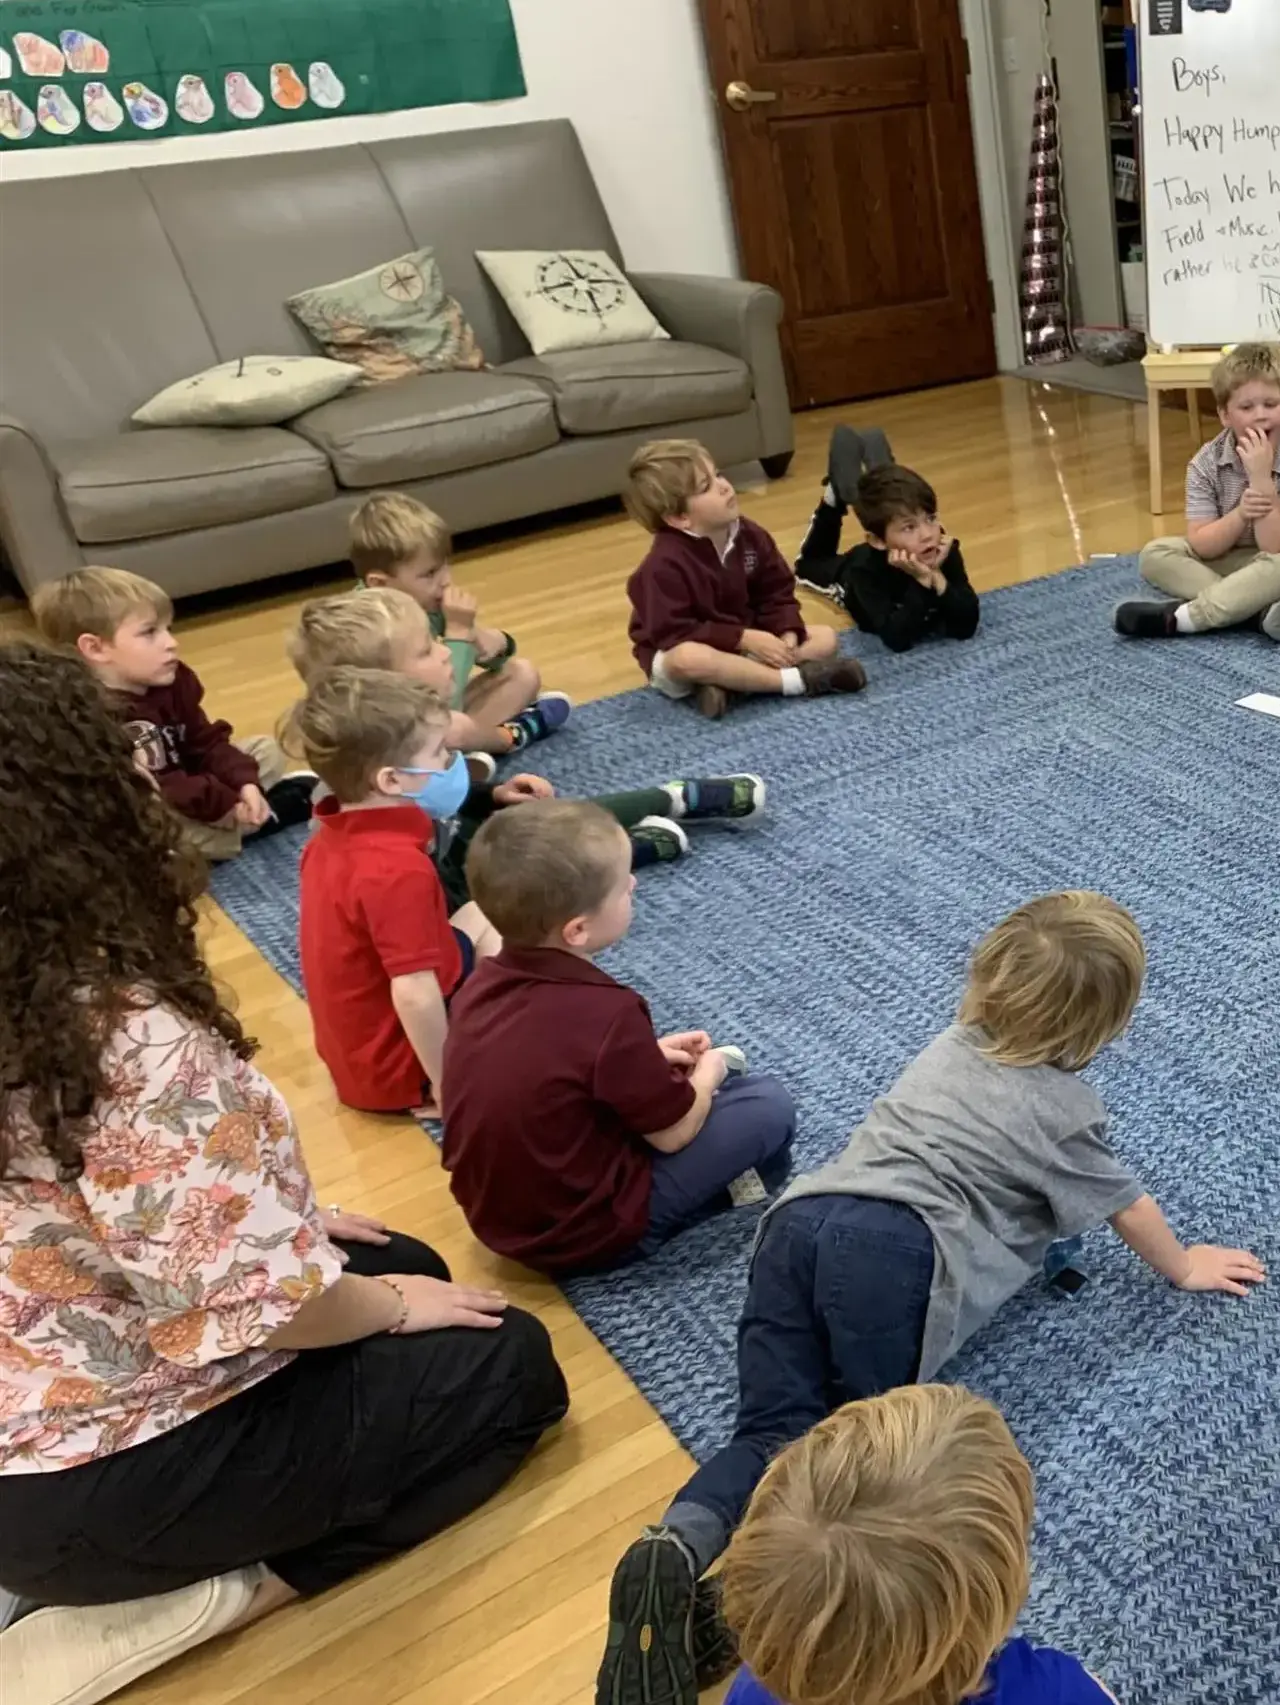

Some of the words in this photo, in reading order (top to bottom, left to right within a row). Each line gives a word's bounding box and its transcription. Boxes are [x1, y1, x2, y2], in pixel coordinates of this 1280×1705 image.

[1172, 57, 1226, 97] Boys,
[1164, 115, 1223, 154] Happy
[1232, 117, 1280, 151] Hump
[1153, 176, 1211, 214] Today
[1223, 173, 1257, 203] We
[1161, 219, 1204, 252] Field
[1163, 259, 1213, 286] rather
